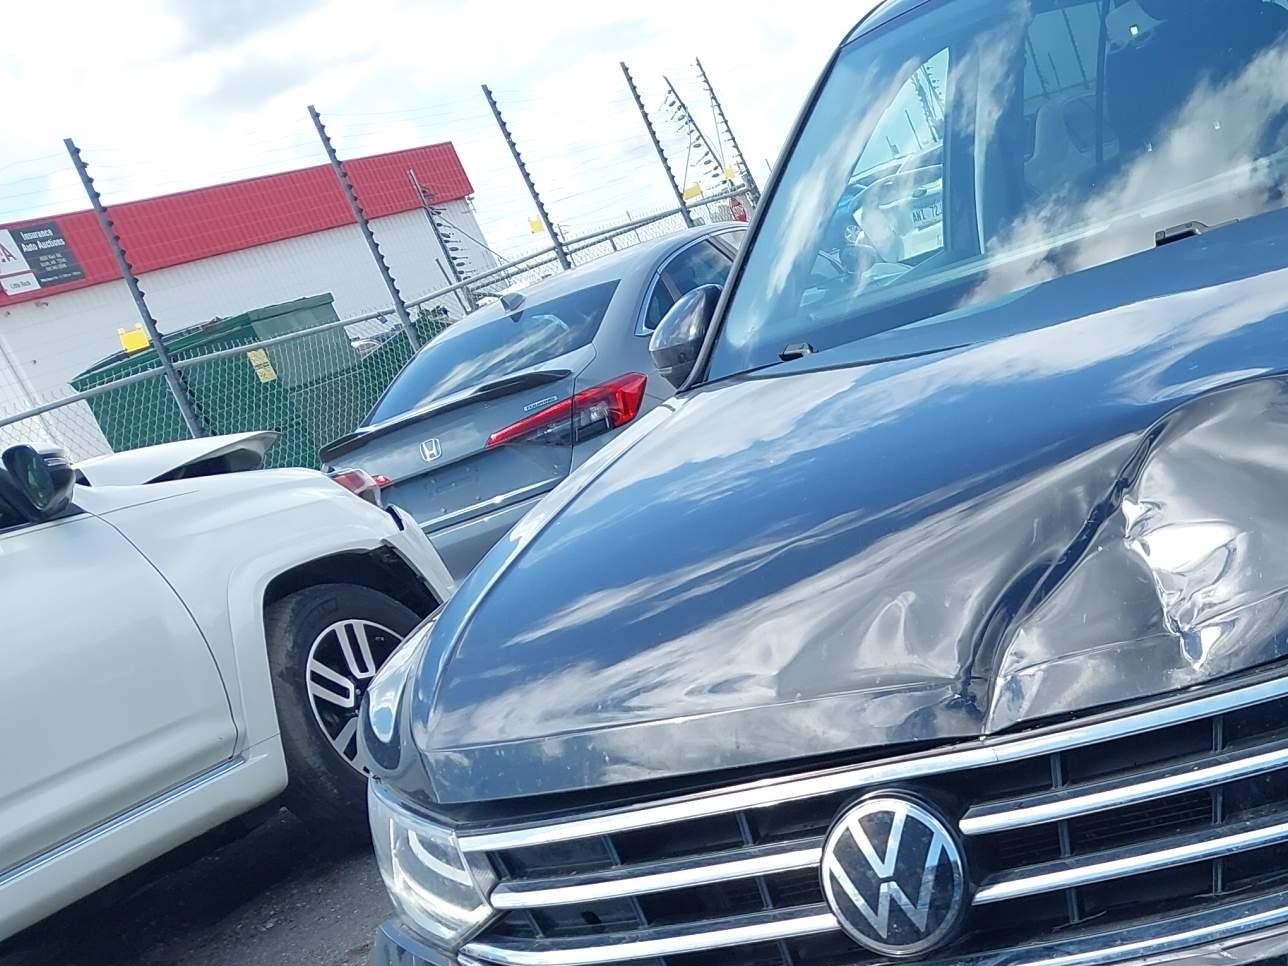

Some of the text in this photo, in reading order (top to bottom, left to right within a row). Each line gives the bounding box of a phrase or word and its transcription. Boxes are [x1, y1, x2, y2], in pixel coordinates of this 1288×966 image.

[20, 229, 54, 241] Insurance
[21, 238, 66, 253] Auto Auctions
